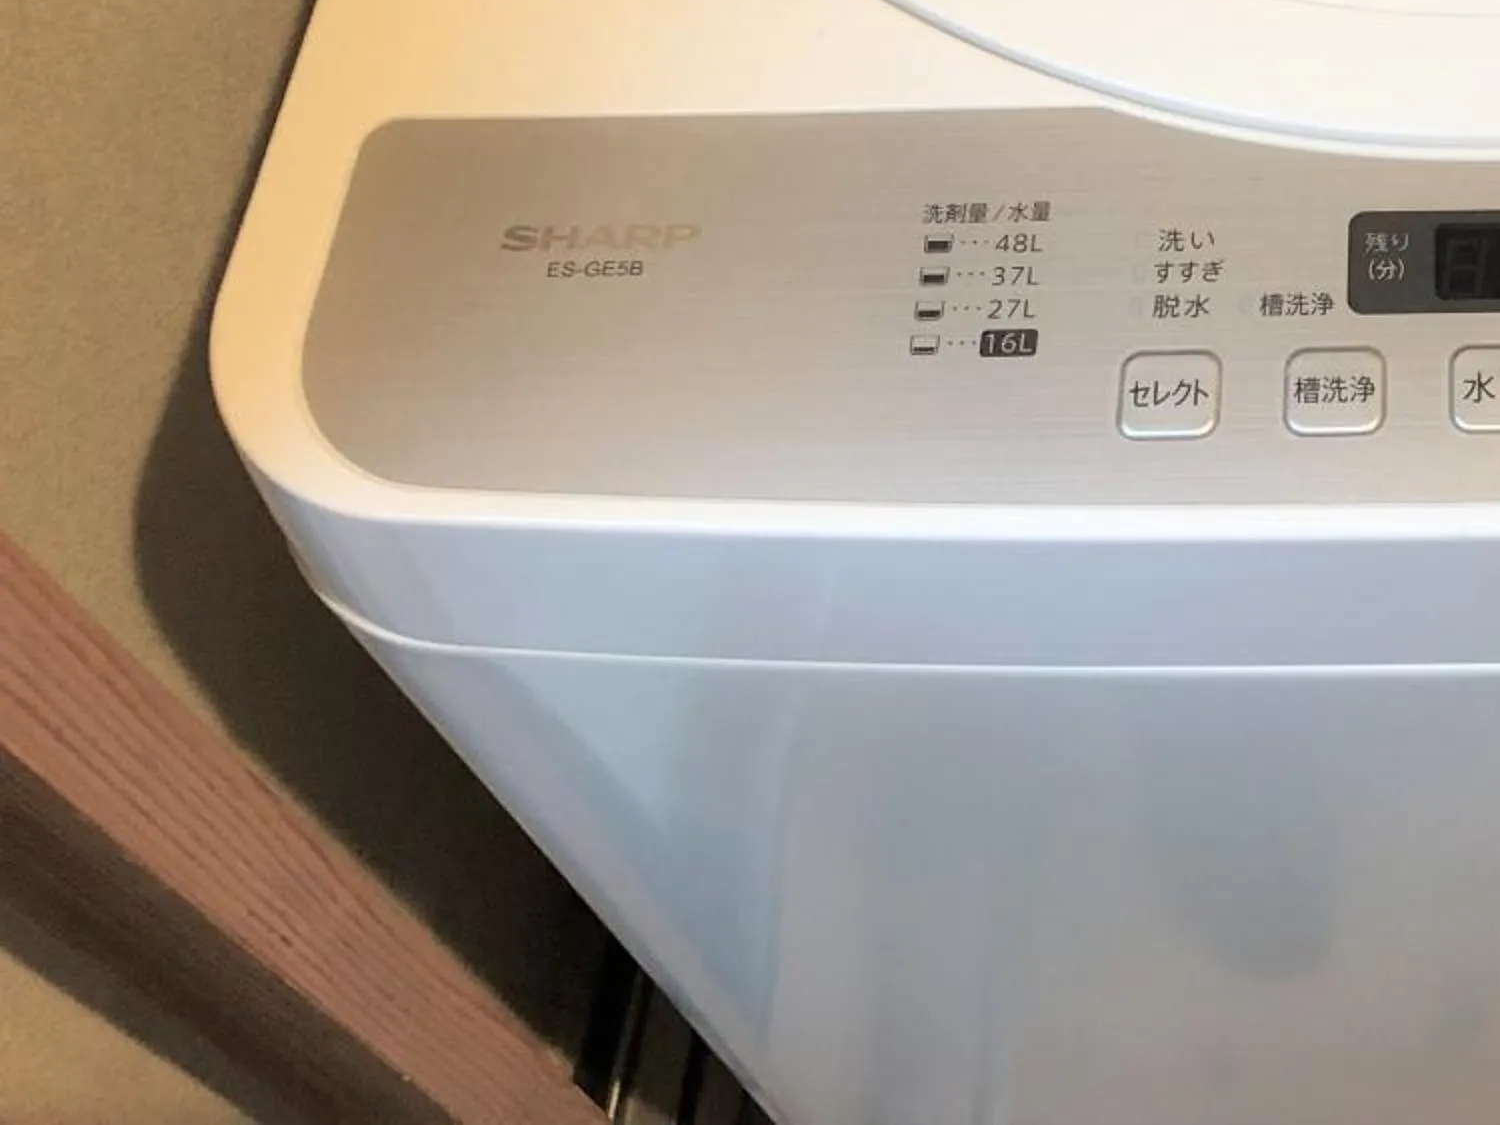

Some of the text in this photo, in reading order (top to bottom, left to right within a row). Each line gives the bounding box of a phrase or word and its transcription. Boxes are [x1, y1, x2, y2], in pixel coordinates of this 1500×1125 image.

[500, 224, 703, 252] SHARP
[994, 233, 1044, 253] 48L
[1157, 228, 1216, 253] 洗い
[1364, 231, 1410, 253] 残り
[546, 260, 645, 278] ES-GE5B
[991, 266, 1040, 286] 37L
[1153, 259, 1225, 284] すすぎ
[1367, 258, 1405, 282] (分)
[987, 298, 1037, 319] 27L
[1152, 293, 1210, 319] 脱水
[1259, 291, 1335, 317] 槽洗浄
[984, 332, 1033, 354] 16L
[1129, 377, 1210, 409] セレクト
[1293, 376, 1376, 405] 槽洗浄
